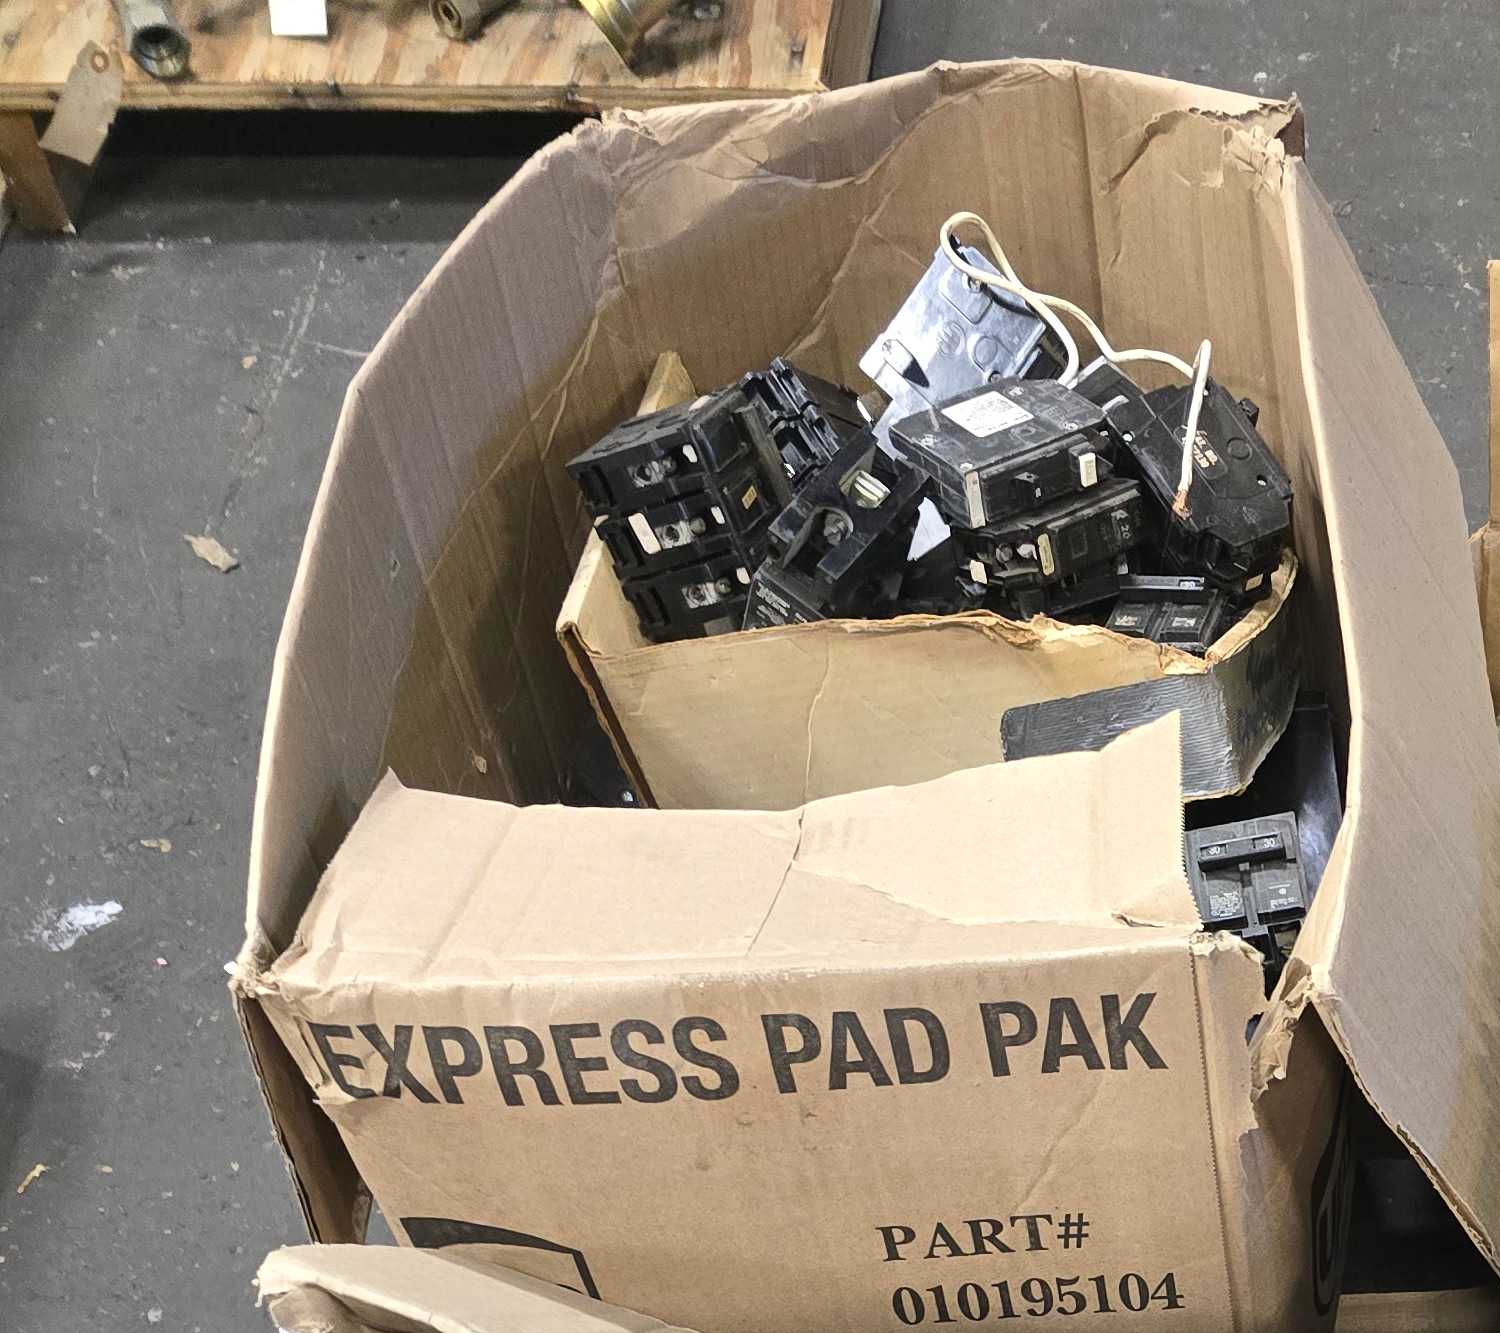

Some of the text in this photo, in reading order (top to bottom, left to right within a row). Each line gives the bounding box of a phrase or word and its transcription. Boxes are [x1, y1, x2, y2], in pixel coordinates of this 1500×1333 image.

[306, 992, 1168, 1106] EXPRESS PAD PAK
[875, 1213, 1090, 1261] PART#
[892, 1272, 1185, 1325] 010195104
